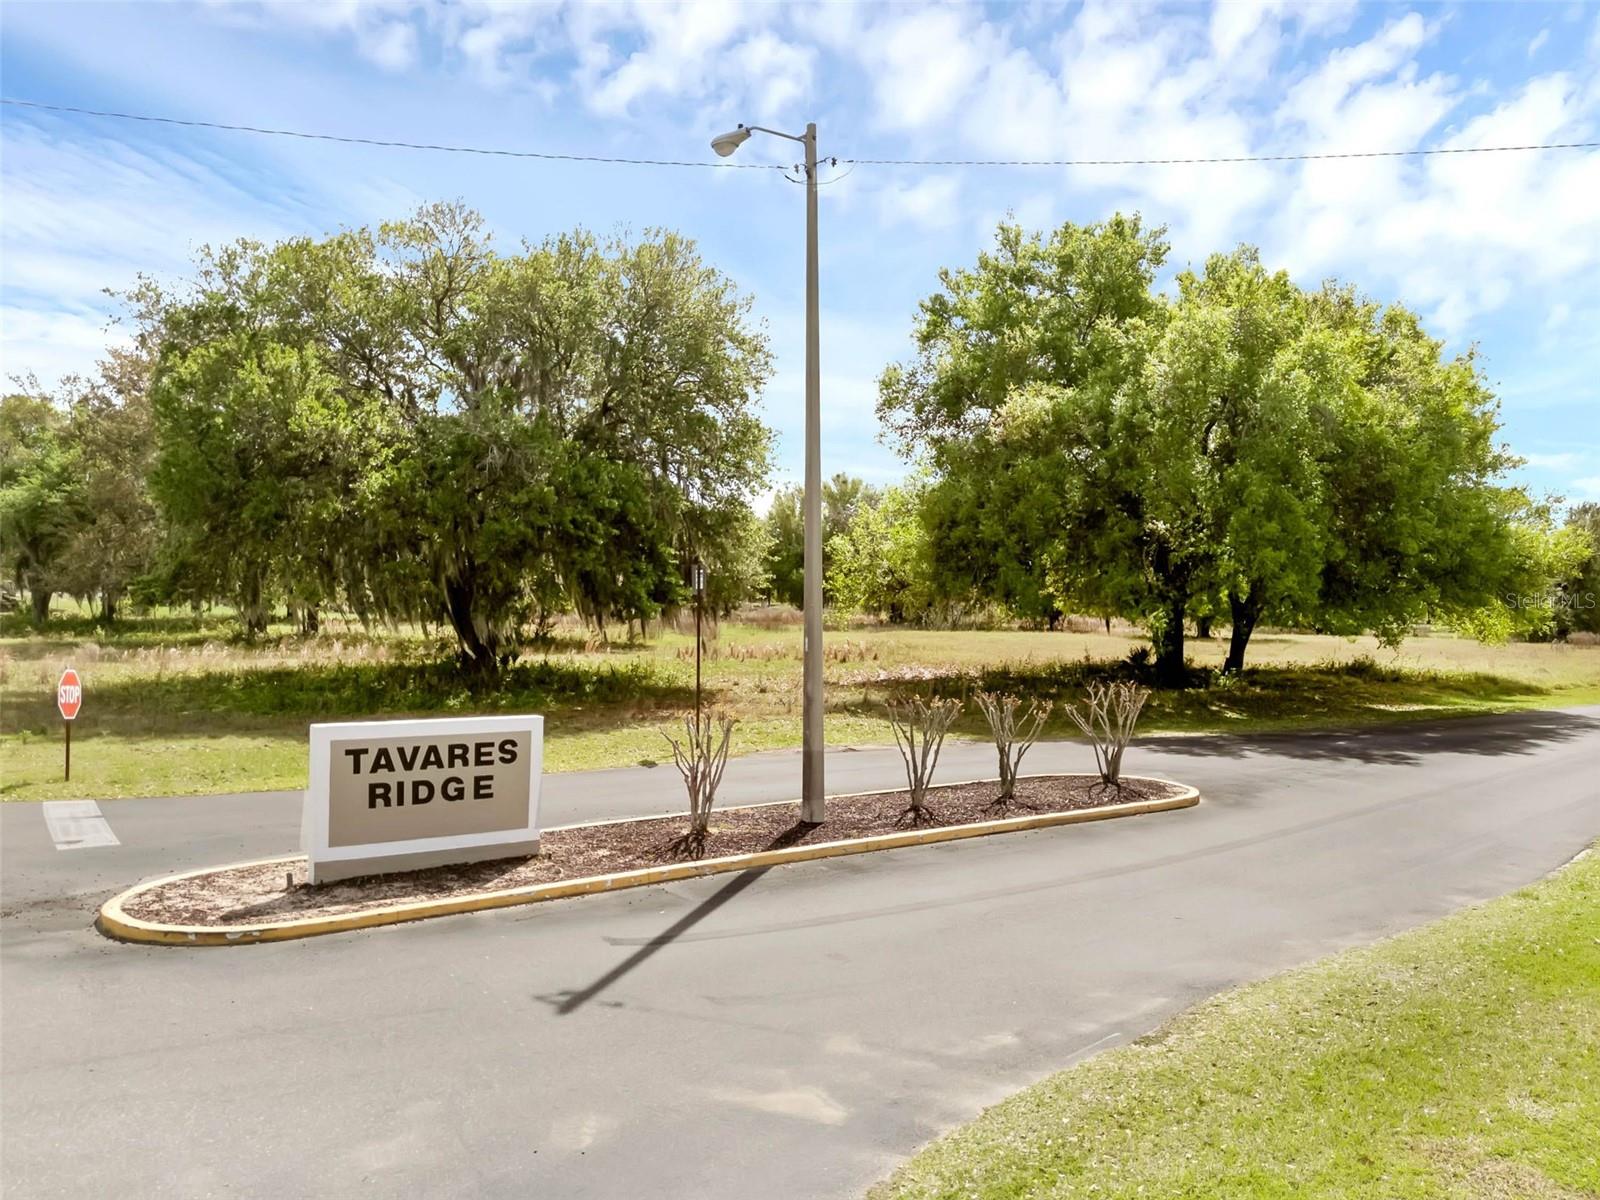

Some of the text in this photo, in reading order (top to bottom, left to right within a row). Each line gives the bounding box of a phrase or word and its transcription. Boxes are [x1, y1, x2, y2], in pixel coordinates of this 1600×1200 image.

[60, 685, 80, 704] STOP
[345, 739, 518, 774] TAVARES
[368, 775, 494, 809] RIDGE
